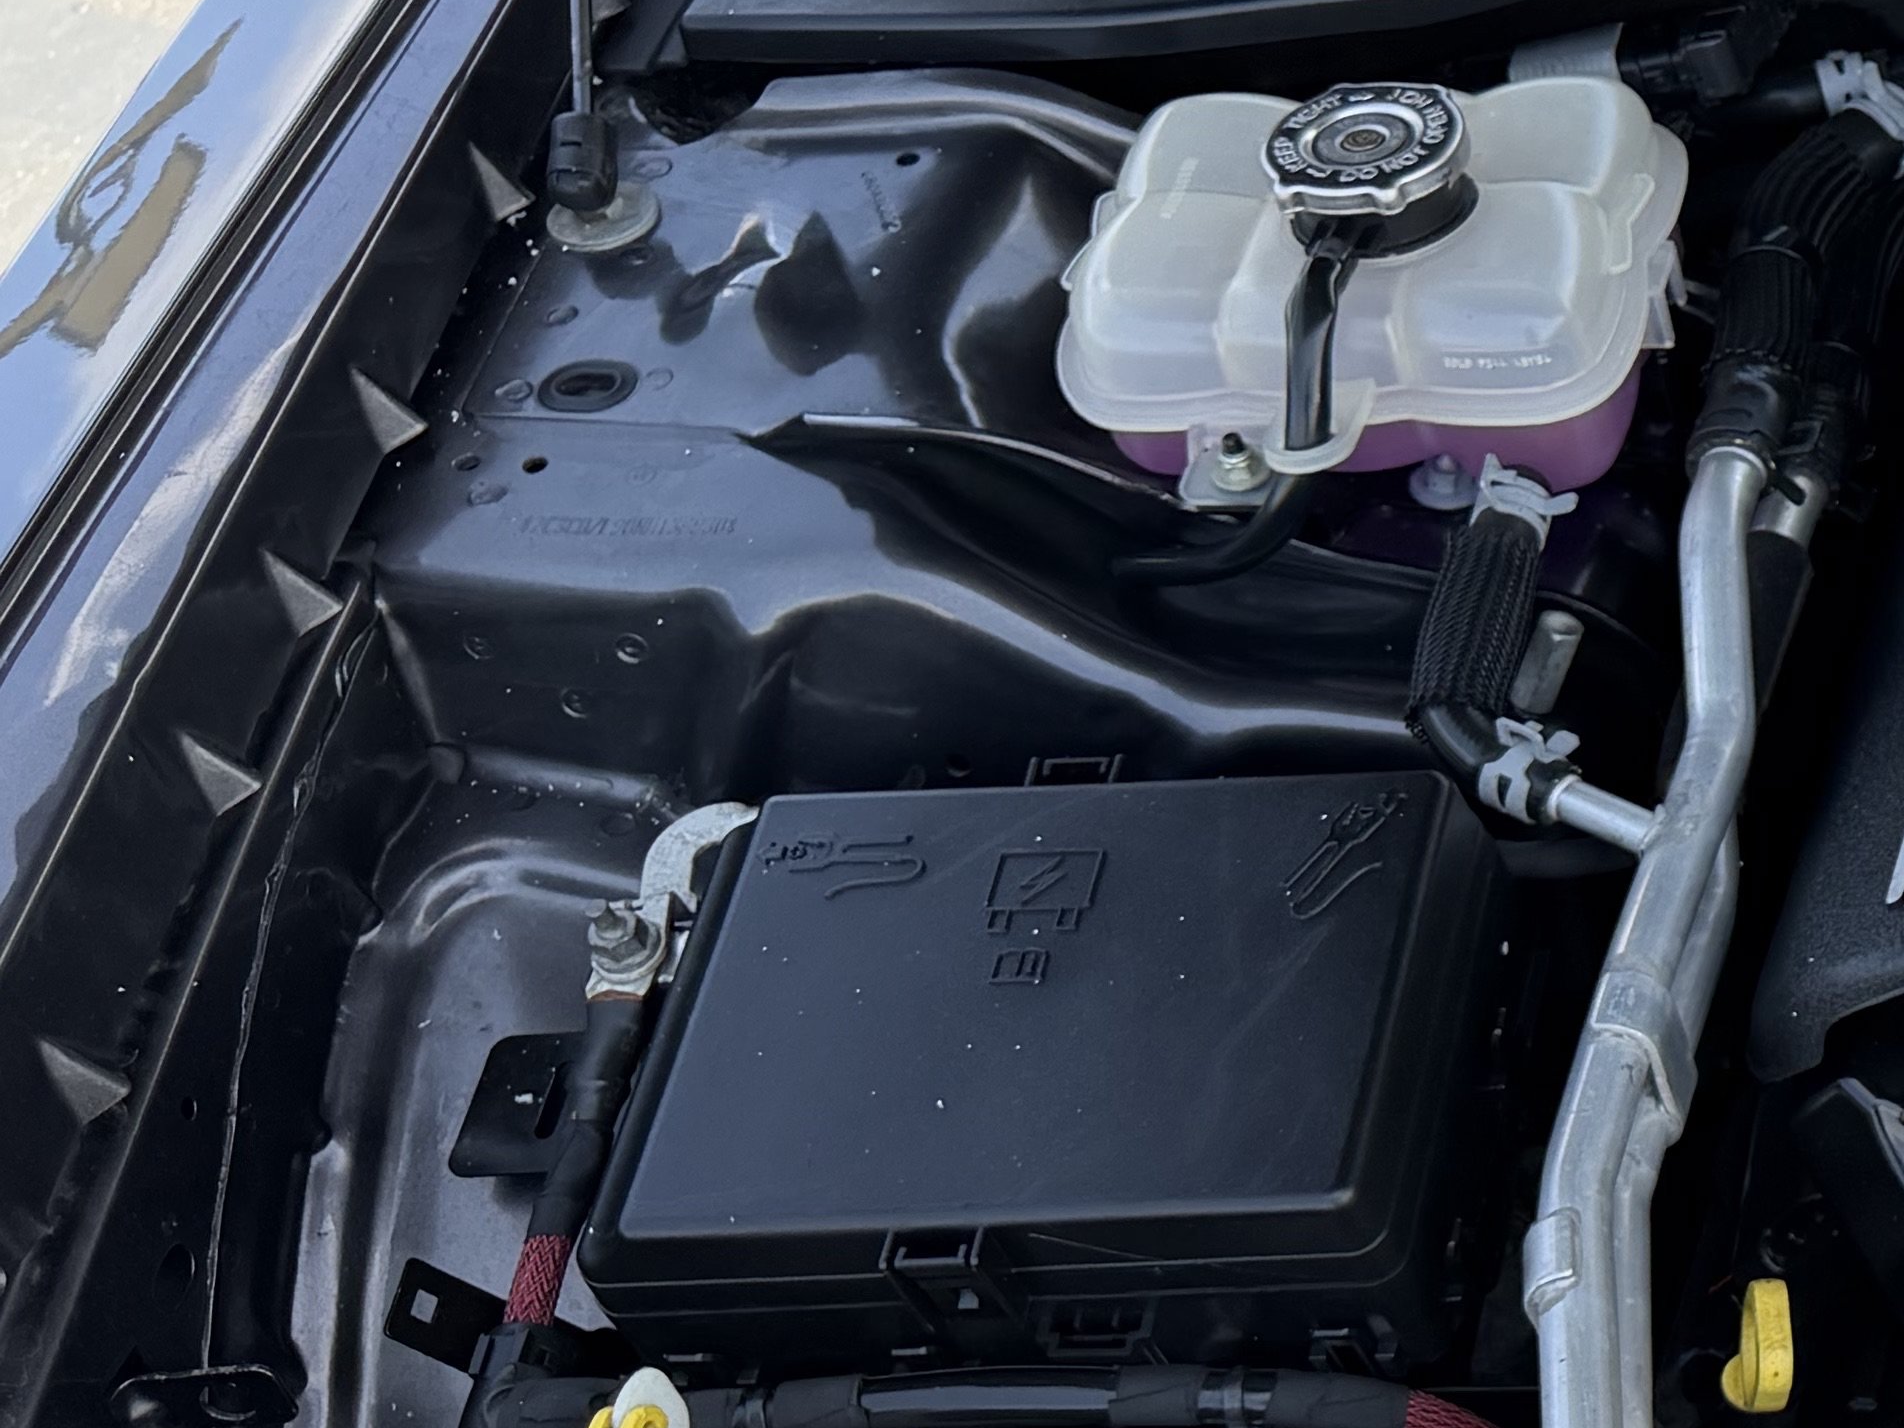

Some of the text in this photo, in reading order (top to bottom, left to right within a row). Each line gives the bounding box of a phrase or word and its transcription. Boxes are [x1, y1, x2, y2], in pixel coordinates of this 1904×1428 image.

[1272, 136, 1309, 174] KEEP
[1339, 167, 1379, 183] DO
[1380, 145, 1430, 173] NOT
